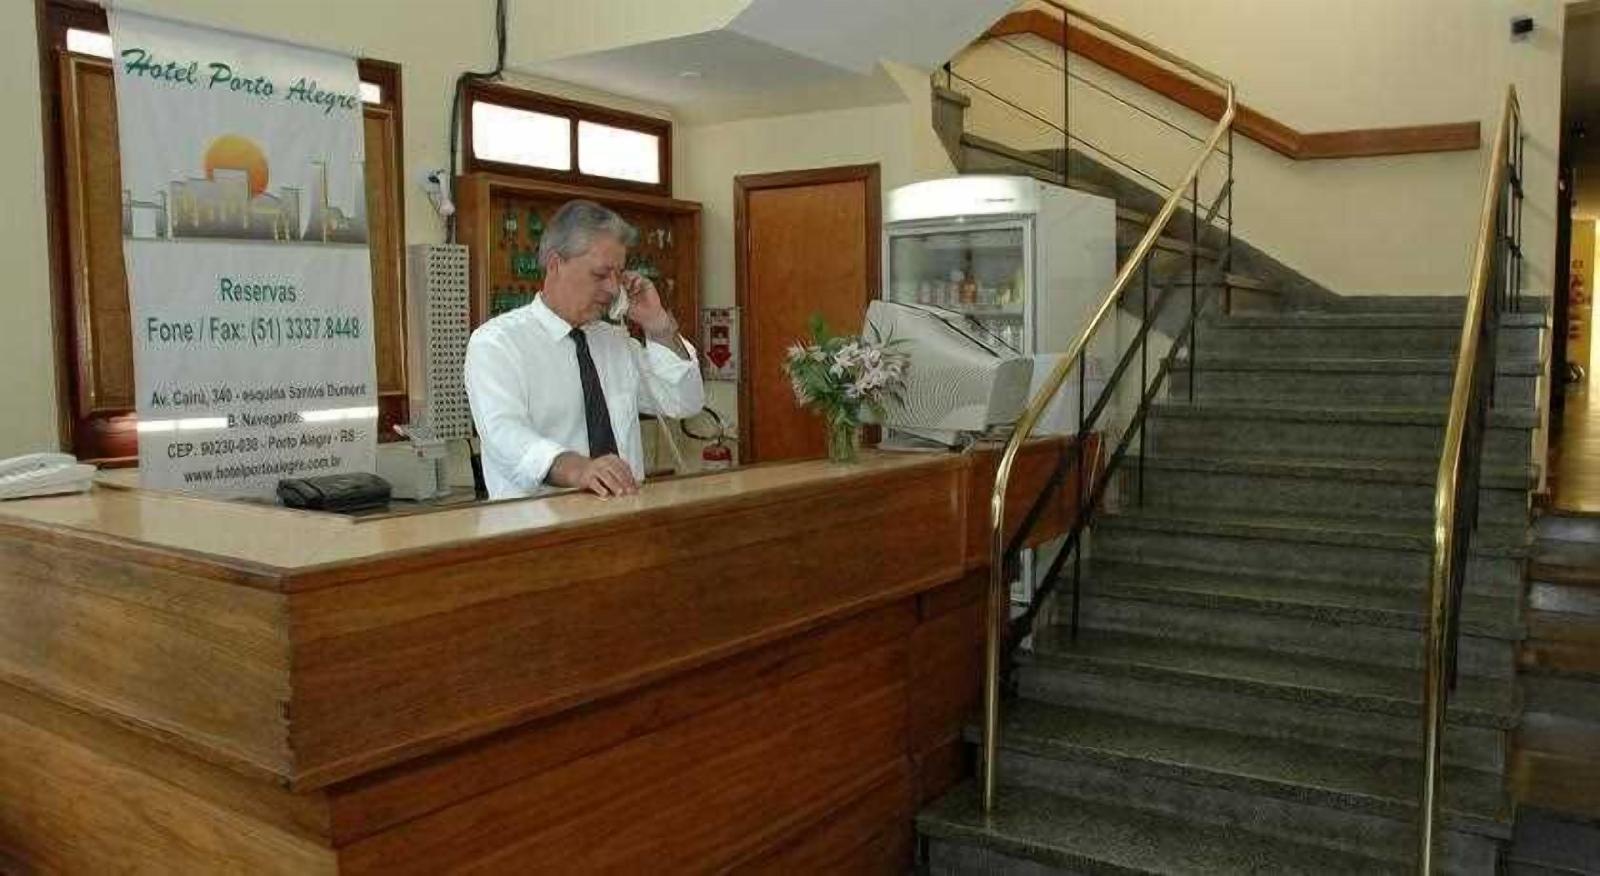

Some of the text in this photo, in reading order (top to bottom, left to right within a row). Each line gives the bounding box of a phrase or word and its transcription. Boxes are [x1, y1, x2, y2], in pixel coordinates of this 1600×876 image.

[121, 48, 359, 115] Hotel Porto Alegre
[220, 277, 297, 303] Reservas
[147, 317, 193, 342] Fone
[209, 316, 246, 341] Fax:
[250, 316, 282, 346] (51)
[285, 316, 361, 340] 3337.8448
[212, 387, 233, 404] 340
[268, 434, 299, 449] Porto
